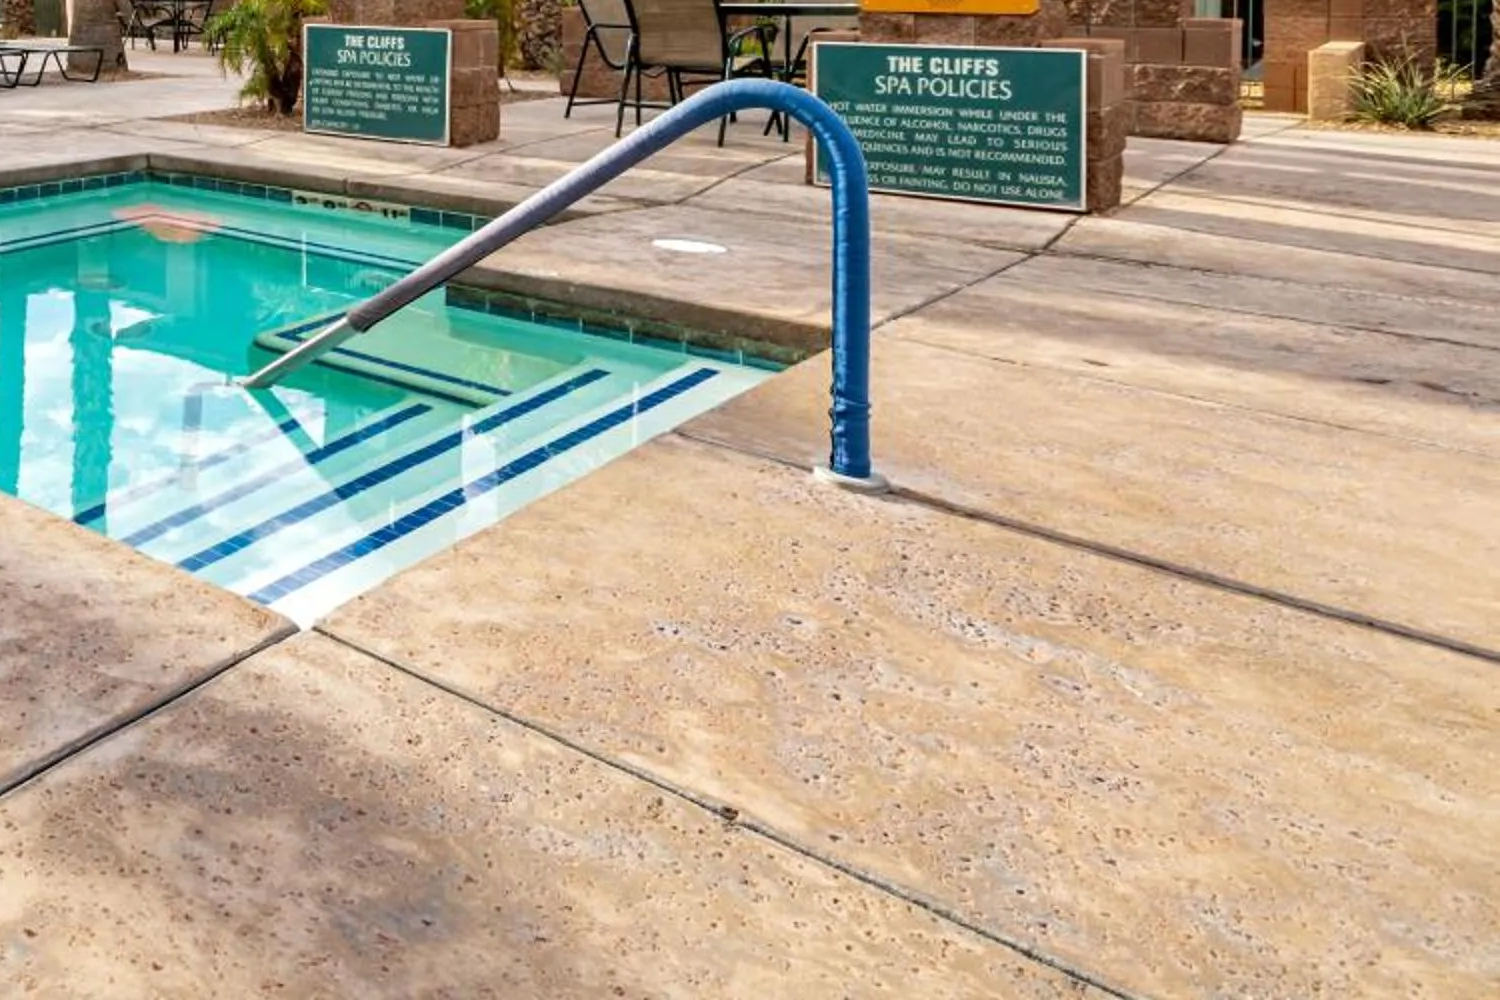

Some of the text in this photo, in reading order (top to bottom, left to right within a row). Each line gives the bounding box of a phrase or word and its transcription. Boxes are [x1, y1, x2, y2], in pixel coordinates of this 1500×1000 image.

[344, 34, 405, 50] THE CLIFFS
[337, 49, 411, 67] SPA POLICIES
[887, 55, 999, 77] THE CLIFFS
[874, 75, 1013, 100] SPA POLICIES
[829, 101, 1067, 124] HOT WATER IMMERSION WHILE UNDER THE
[842, 115, 880, 126] LUENCE
[883, 117, 898, 127] OF
[1027, 125, 1068, 137] DRUGS
[853, 129, 1068, 151] MEDICINE MAY LEAD TO SERIOUS
[910, 145, 933, 156] AND
[935, 147, 946, 157] IS
[948, 148, 971, 159] NOT
[921, 165, 946, 175] MAY
[952, 168, 991, 179] RESULT
[998, 171, 1012, 181] IN
[881, 175, 897, 185] OR
[953, 181, 971, 191] DO
[973, 183, 998, 194] NOT
[1001, 185, 1021, 196] USE
